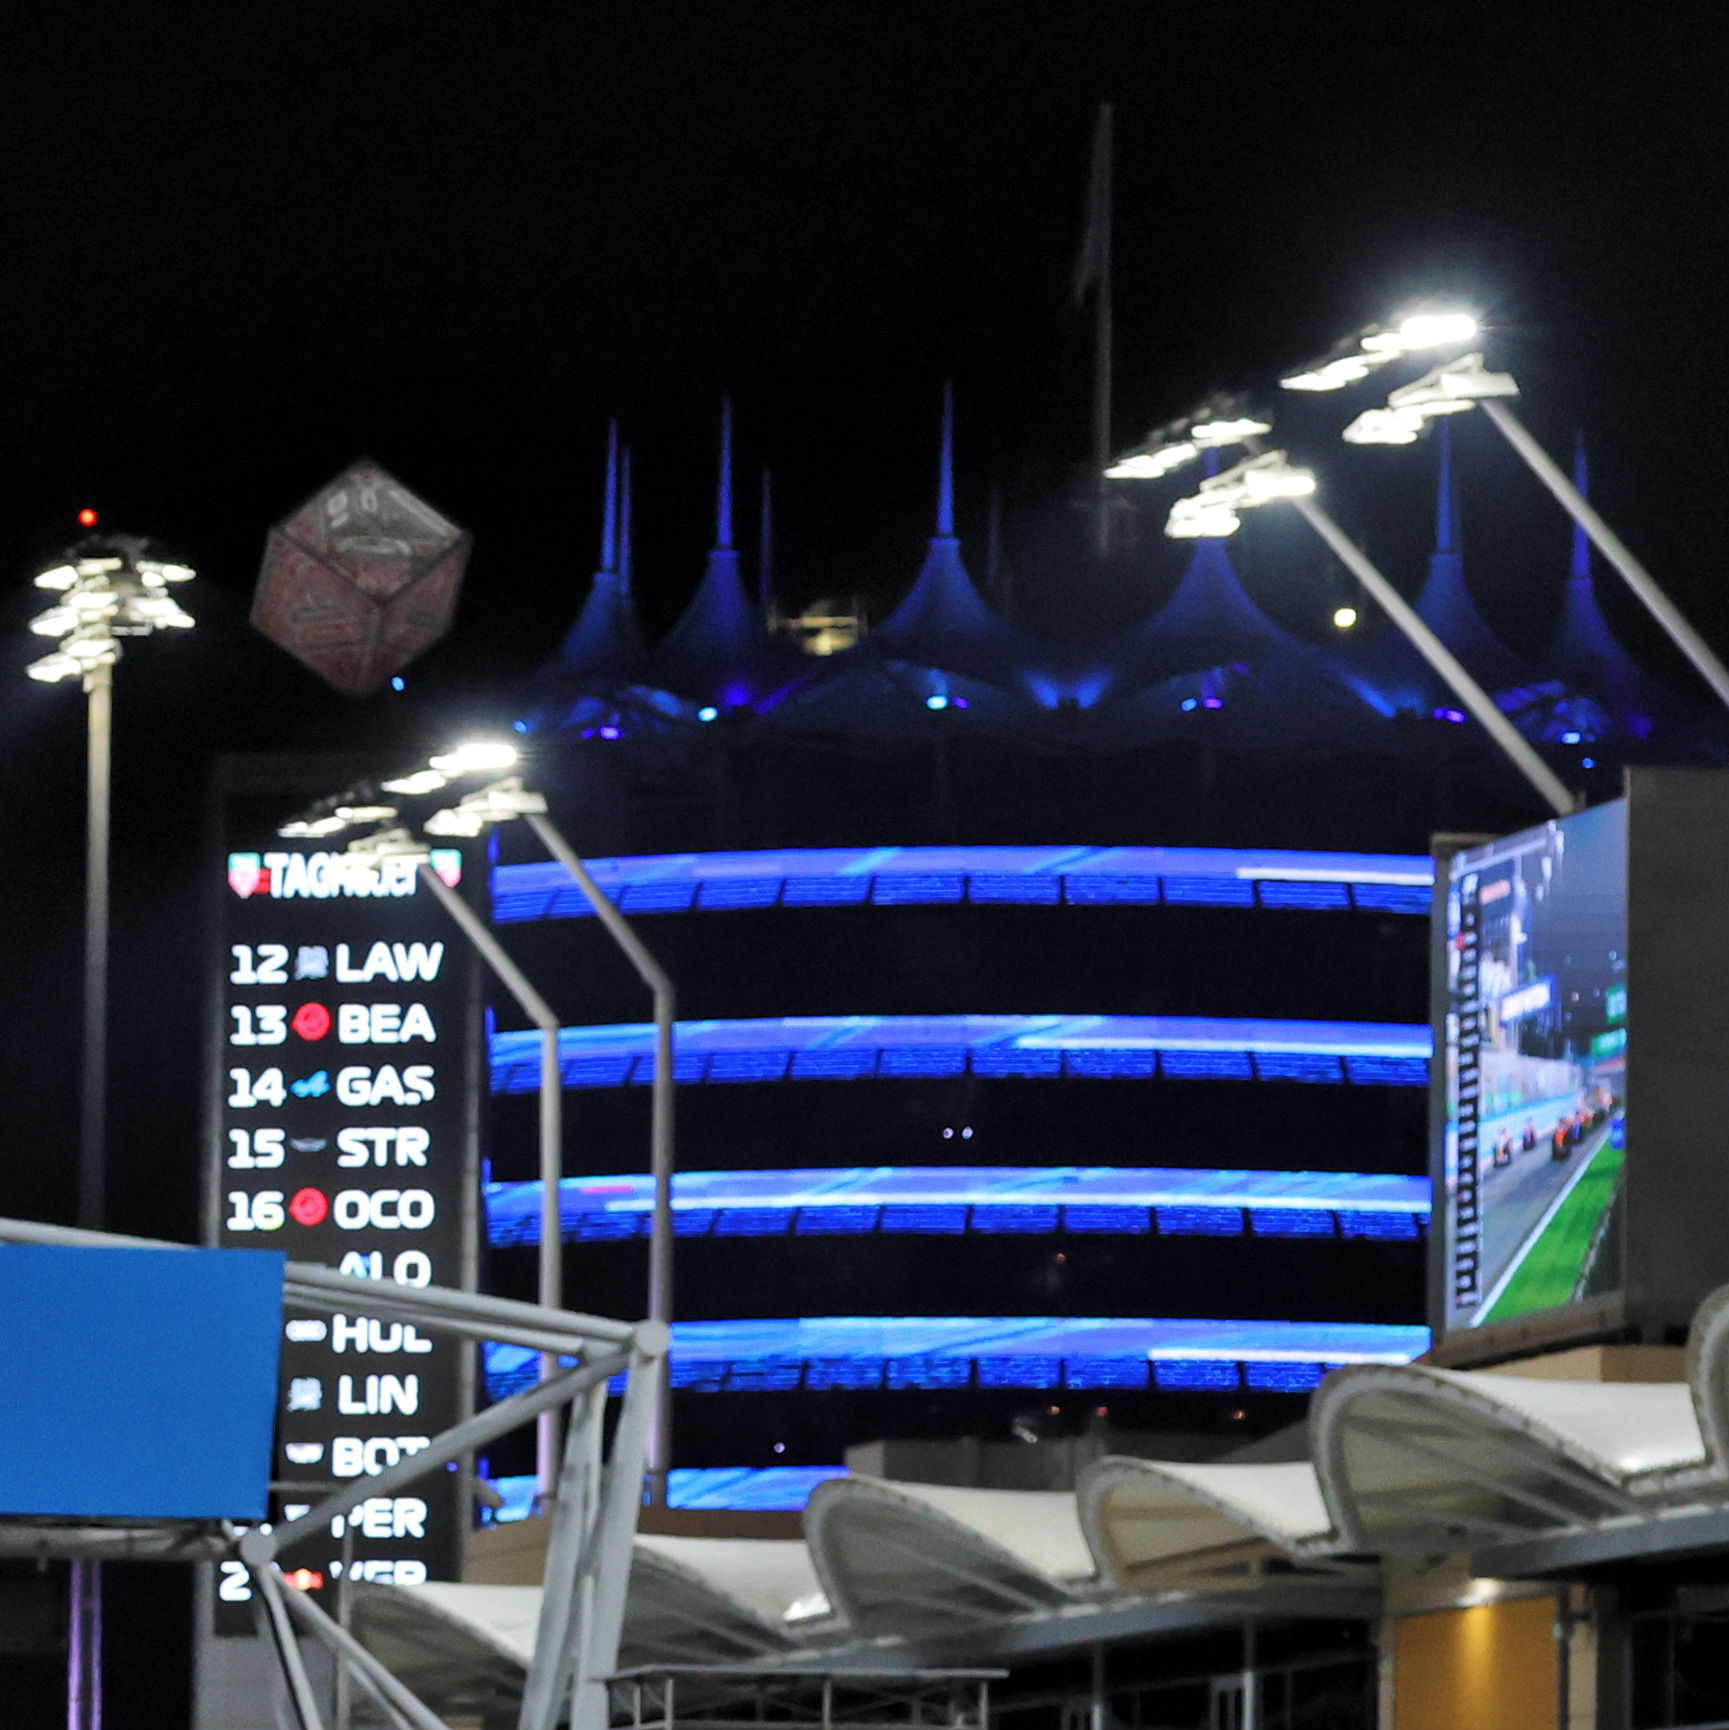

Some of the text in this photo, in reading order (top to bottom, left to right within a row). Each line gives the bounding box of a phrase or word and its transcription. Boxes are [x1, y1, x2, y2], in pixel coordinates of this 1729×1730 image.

[230, 942, 444, 984] 12 LAW
[229, 1003, 436, 1045] 13 BEA
[228, 1064, 435, 1107] 14 GAS
[228, 1127, 430, 1168] 15 STR
[226, 1189, 435, 1231] 16 OCO
[332, 1313, 432, 1353] HUL
[338, 1374, 419, 1415] LIN
